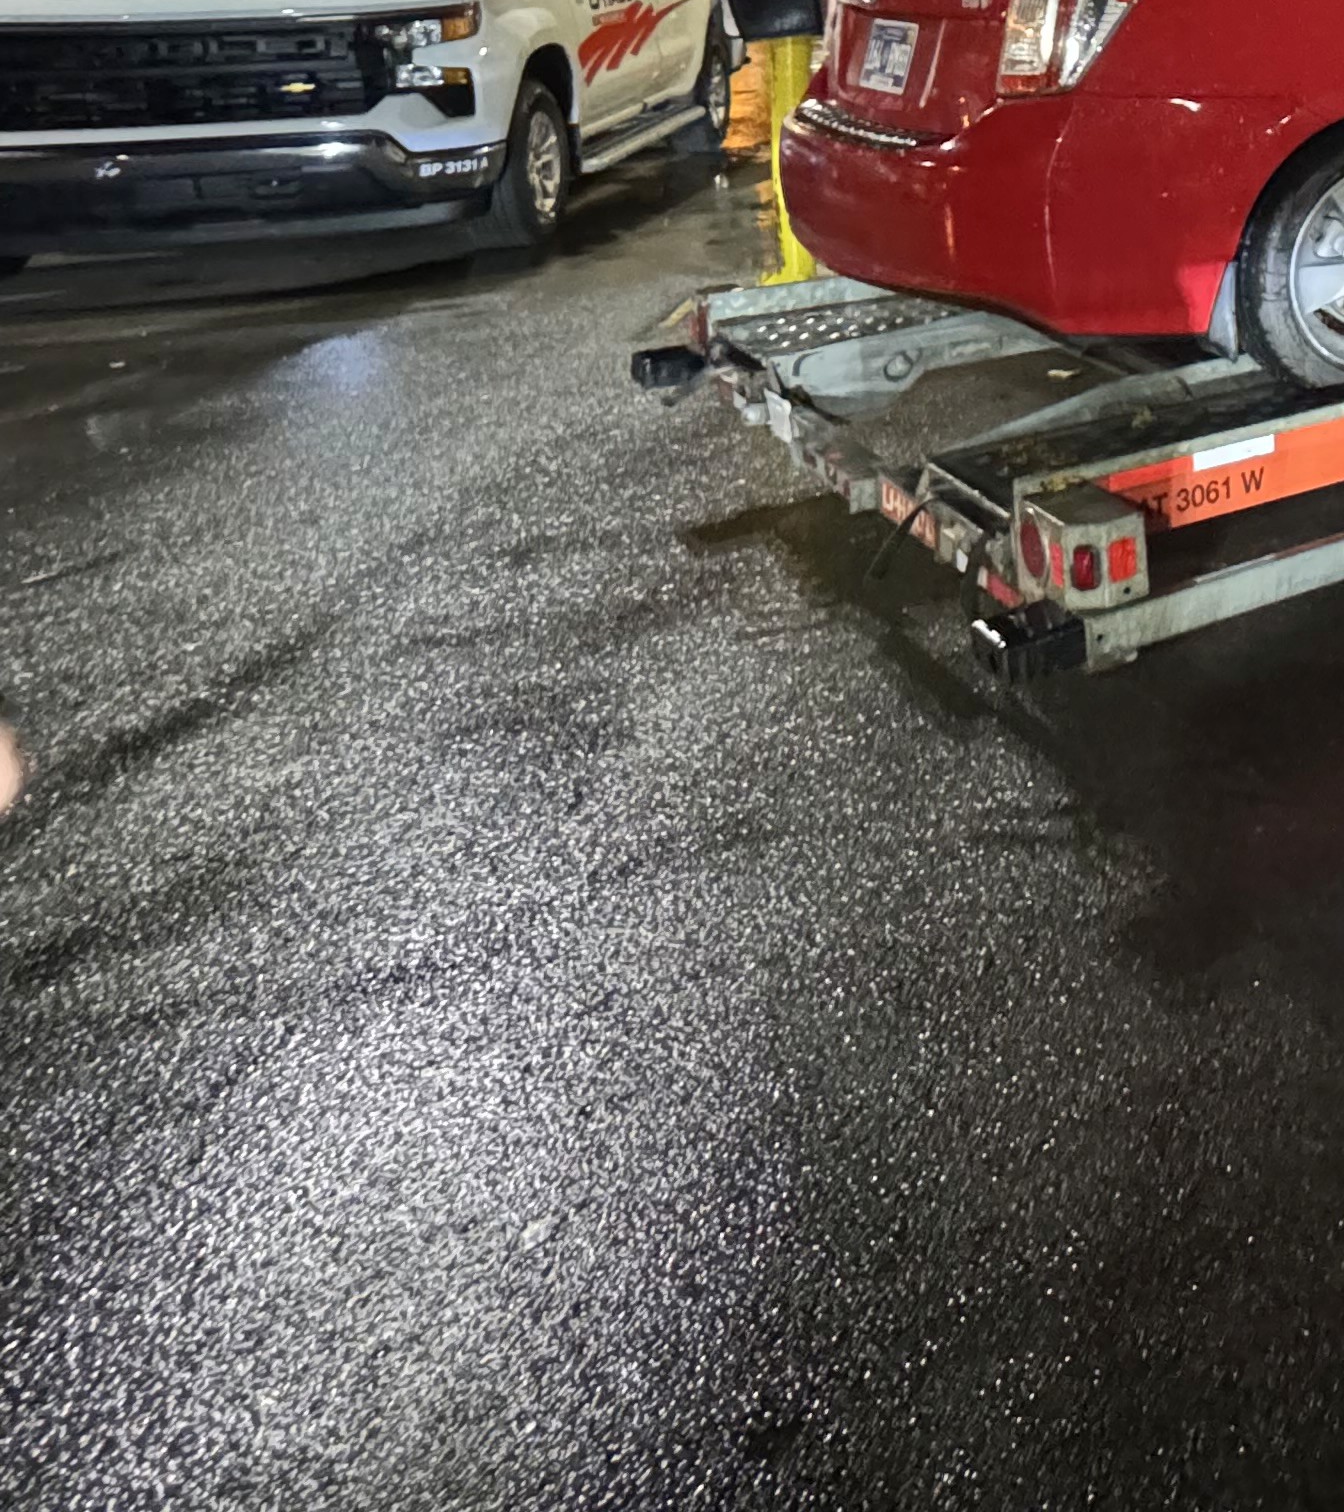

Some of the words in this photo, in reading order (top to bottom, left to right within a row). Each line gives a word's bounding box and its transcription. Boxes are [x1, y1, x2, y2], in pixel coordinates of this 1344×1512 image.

[445, 159, 478, 175] 3131
[480, 156, 489, 169] A
[1175, 474, 1234, 513] 3061
[1240, 466, 1265, 495] W
